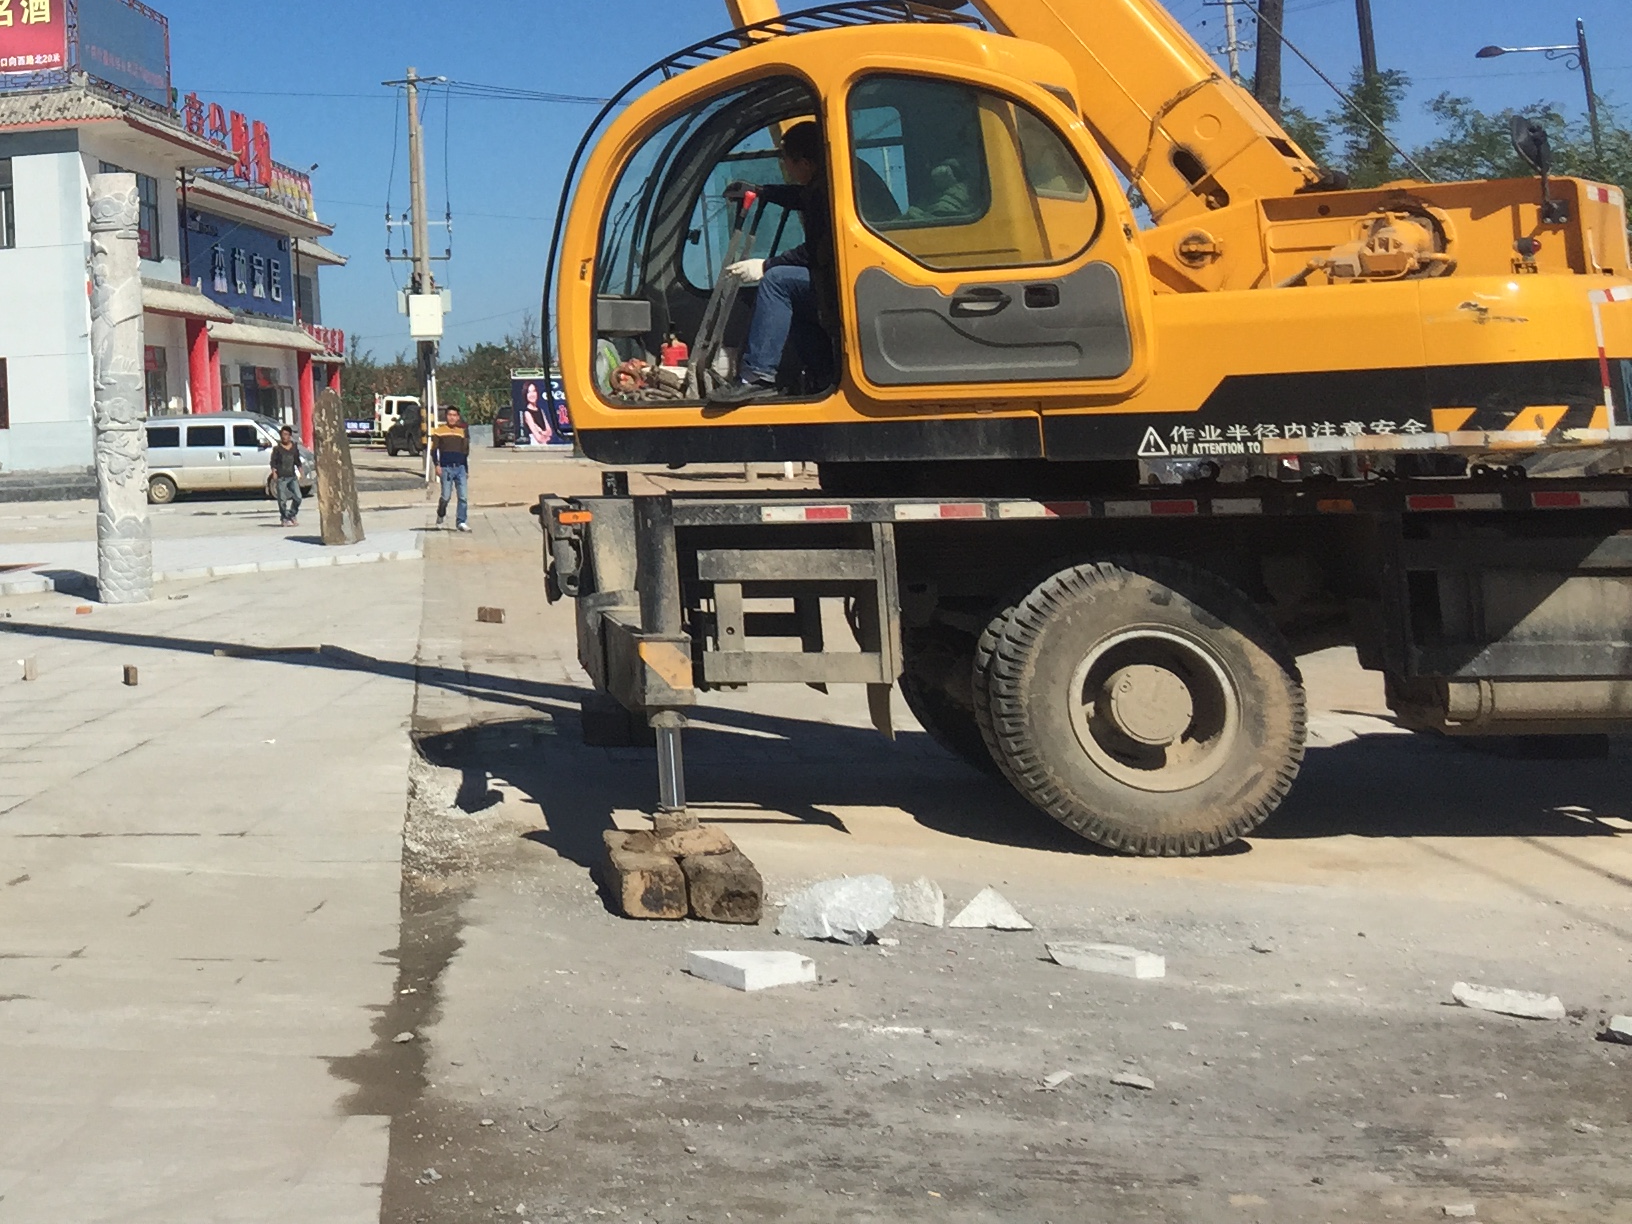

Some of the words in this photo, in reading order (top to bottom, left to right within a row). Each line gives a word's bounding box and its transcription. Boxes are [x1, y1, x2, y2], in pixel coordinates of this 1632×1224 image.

[1169, 418, 1427, 442] 作业半径内注意安全
[1170, 444, 1189, 455] PAY
[1192, 442, 1244, 455] ATTENTION
[1247, 442, 1261, 454] TO
